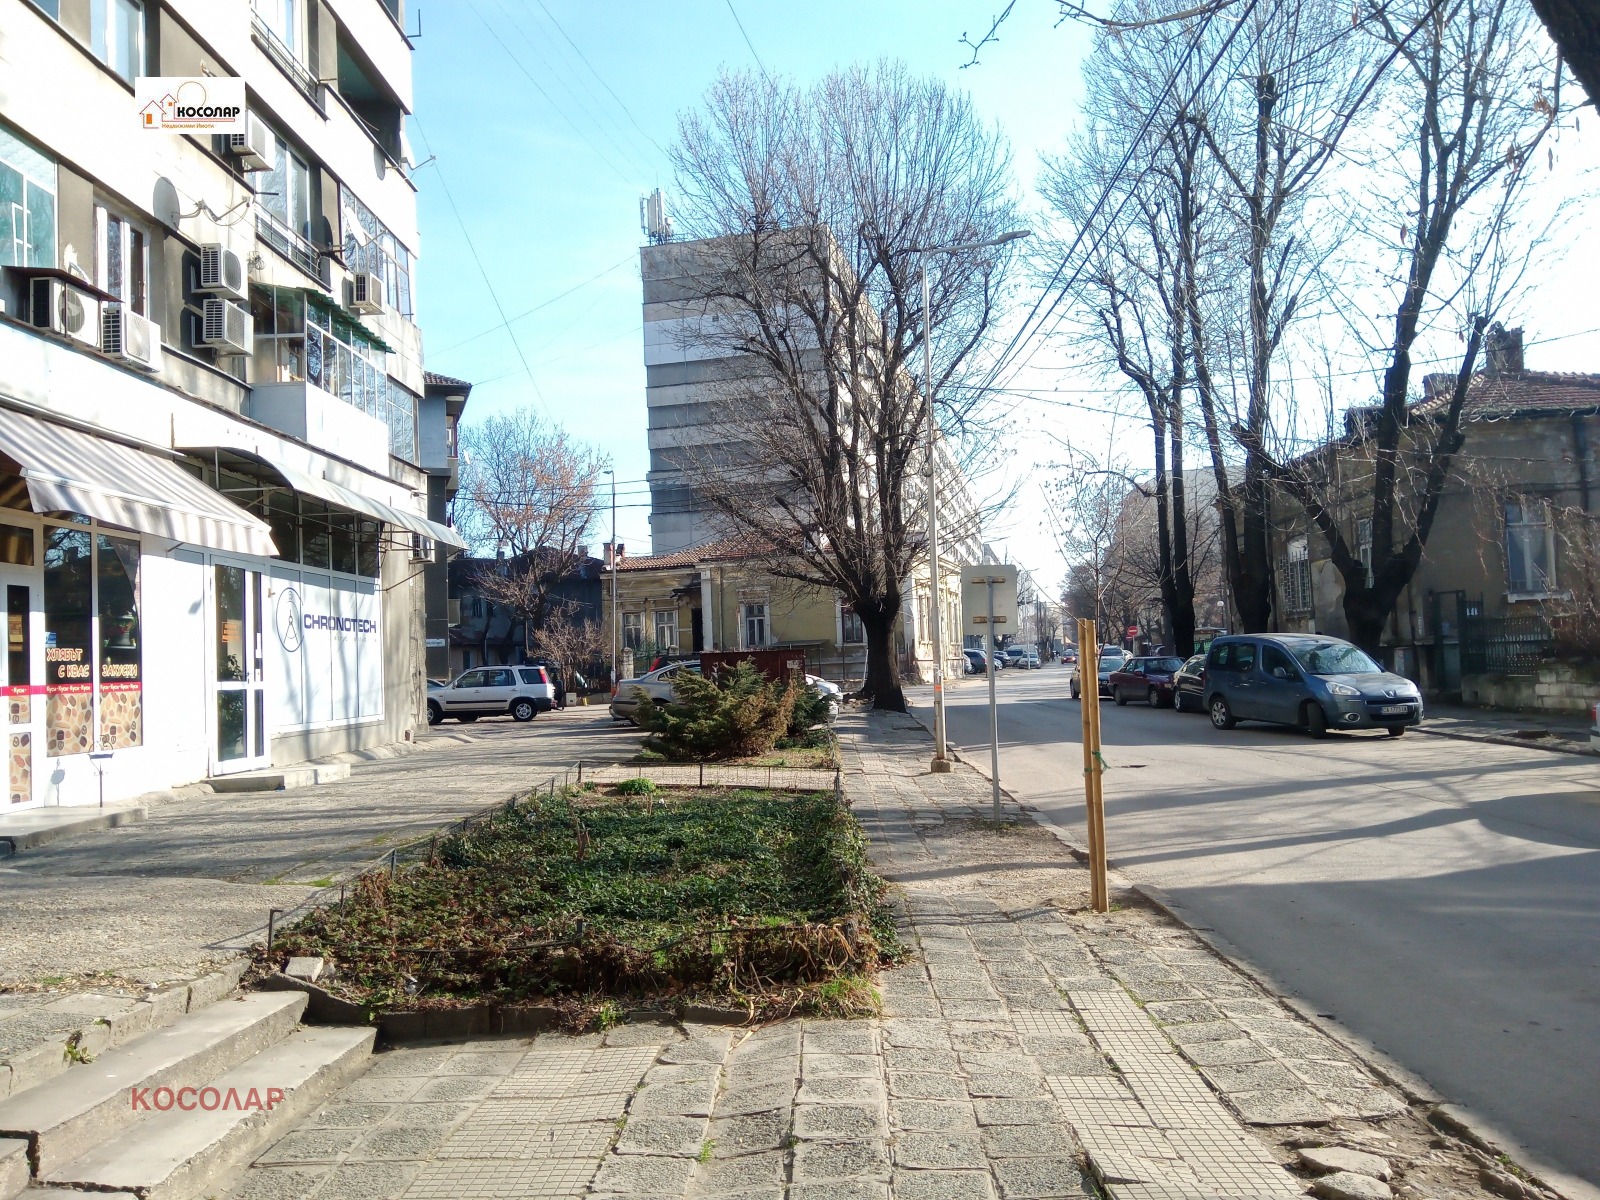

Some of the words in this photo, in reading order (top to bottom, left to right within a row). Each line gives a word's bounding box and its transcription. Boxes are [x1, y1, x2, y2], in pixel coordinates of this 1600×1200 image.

[304, 614, 376, 633] CHRONOTECH
[46, 648, 83, 662] ХЛЯБЪТ
[66, 664, 90, 678] КВАС
[101, 664, 138, 677] ЗАКУСКИ
